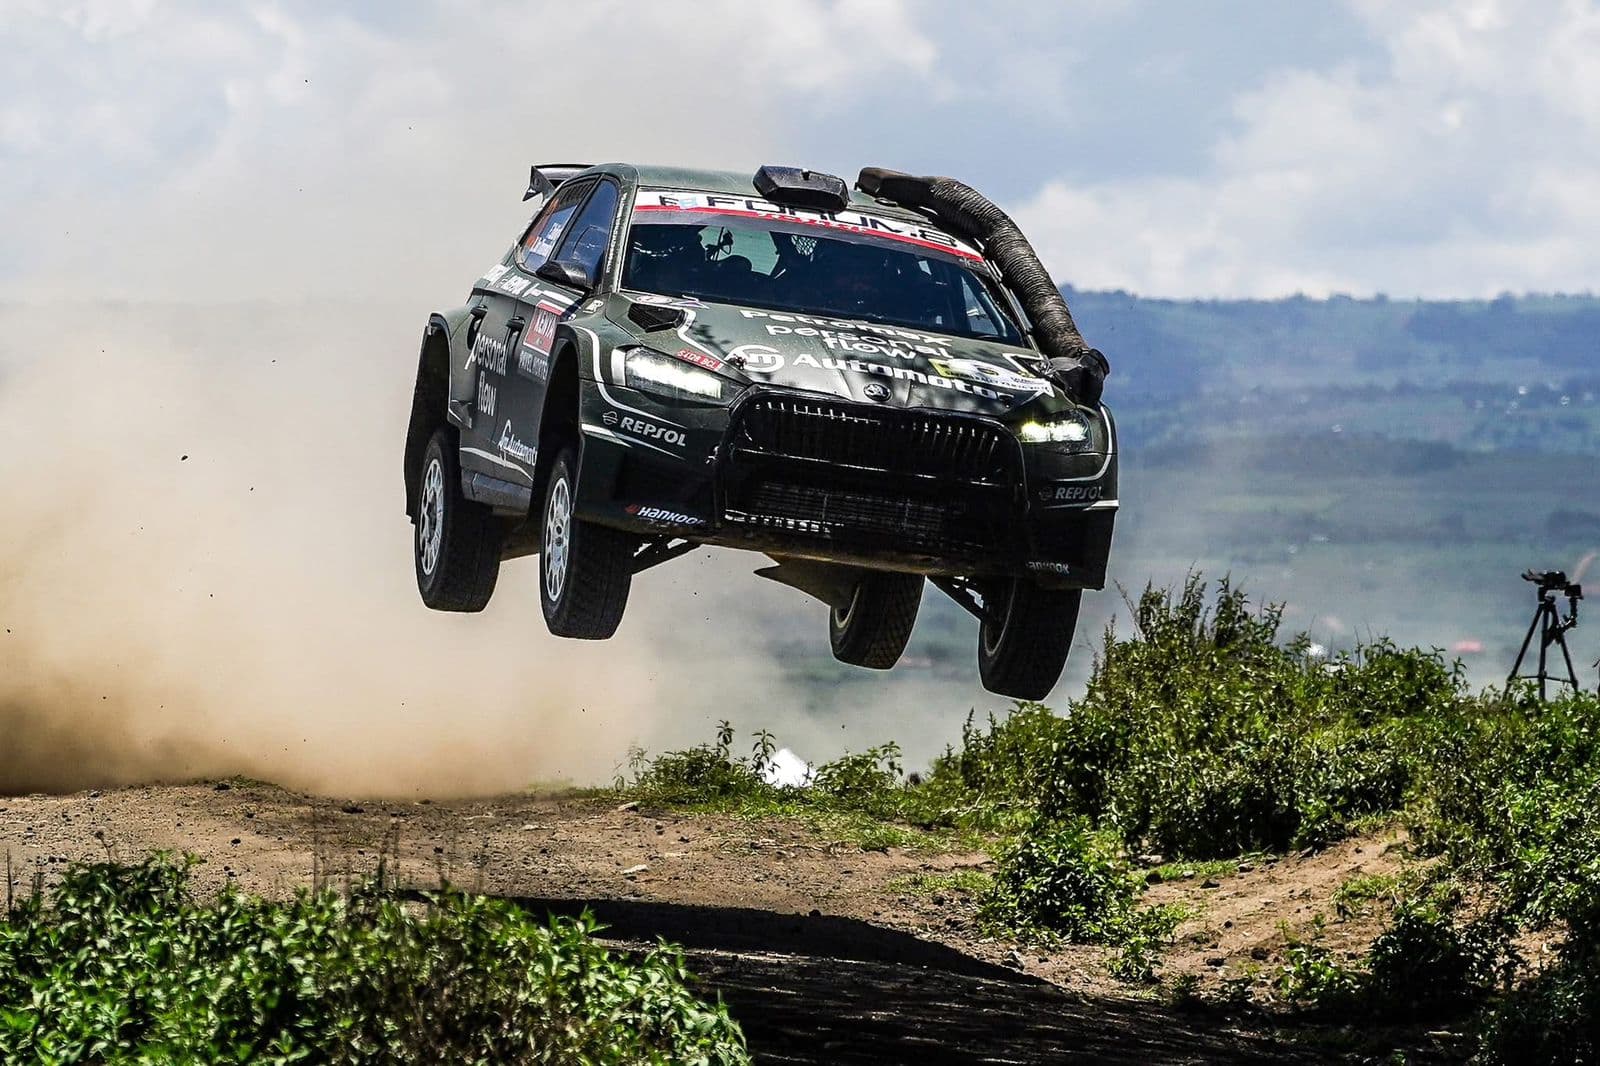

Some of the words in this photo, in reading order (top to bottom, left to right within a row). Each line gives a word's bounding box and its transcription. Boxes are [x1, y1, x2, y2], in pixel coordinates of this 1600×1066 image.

[823, 337, 916, 360] flow
[620, 416, 687, 447] REPSOL
[1055, 486, 1104, 500] REPSOL
